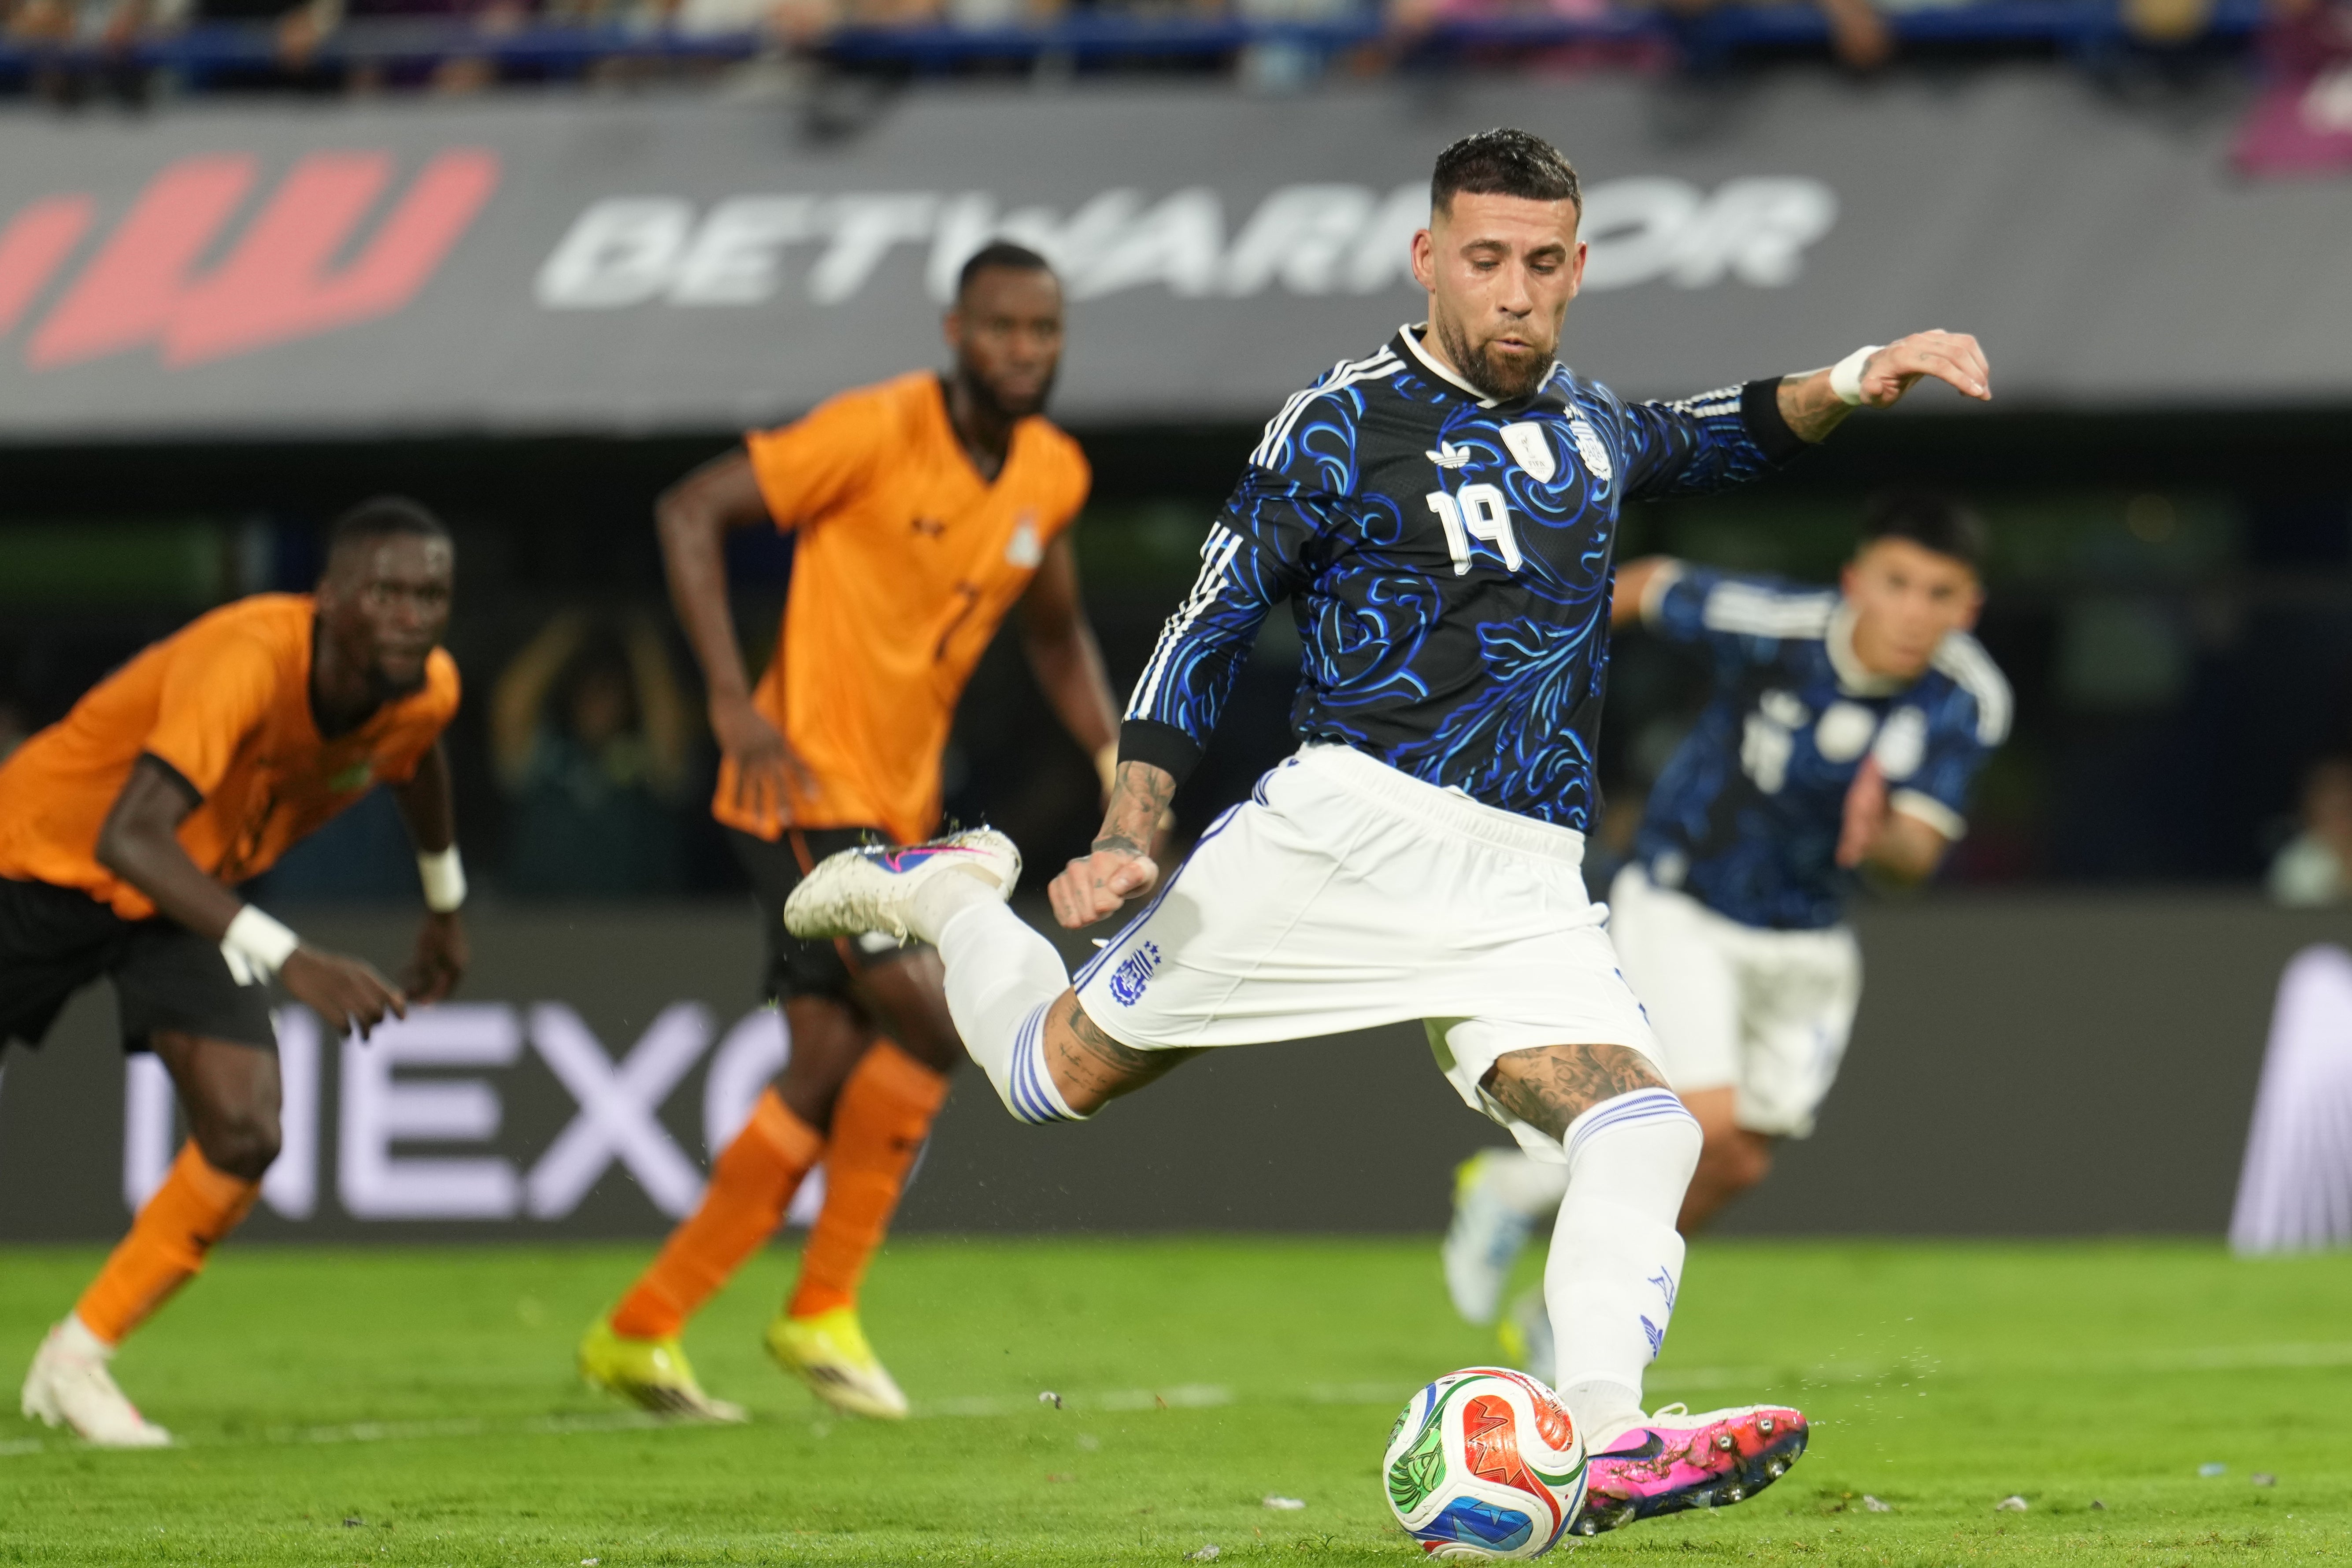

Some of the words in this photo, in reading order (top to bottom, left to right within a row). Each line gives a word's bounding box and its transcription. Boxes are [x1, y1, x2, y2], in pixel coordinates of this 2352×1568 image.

[1426, 484, 1522, 575] 19
[931, 581, 981, 664] 7
[123, 1002, 929, 1223] NEX
